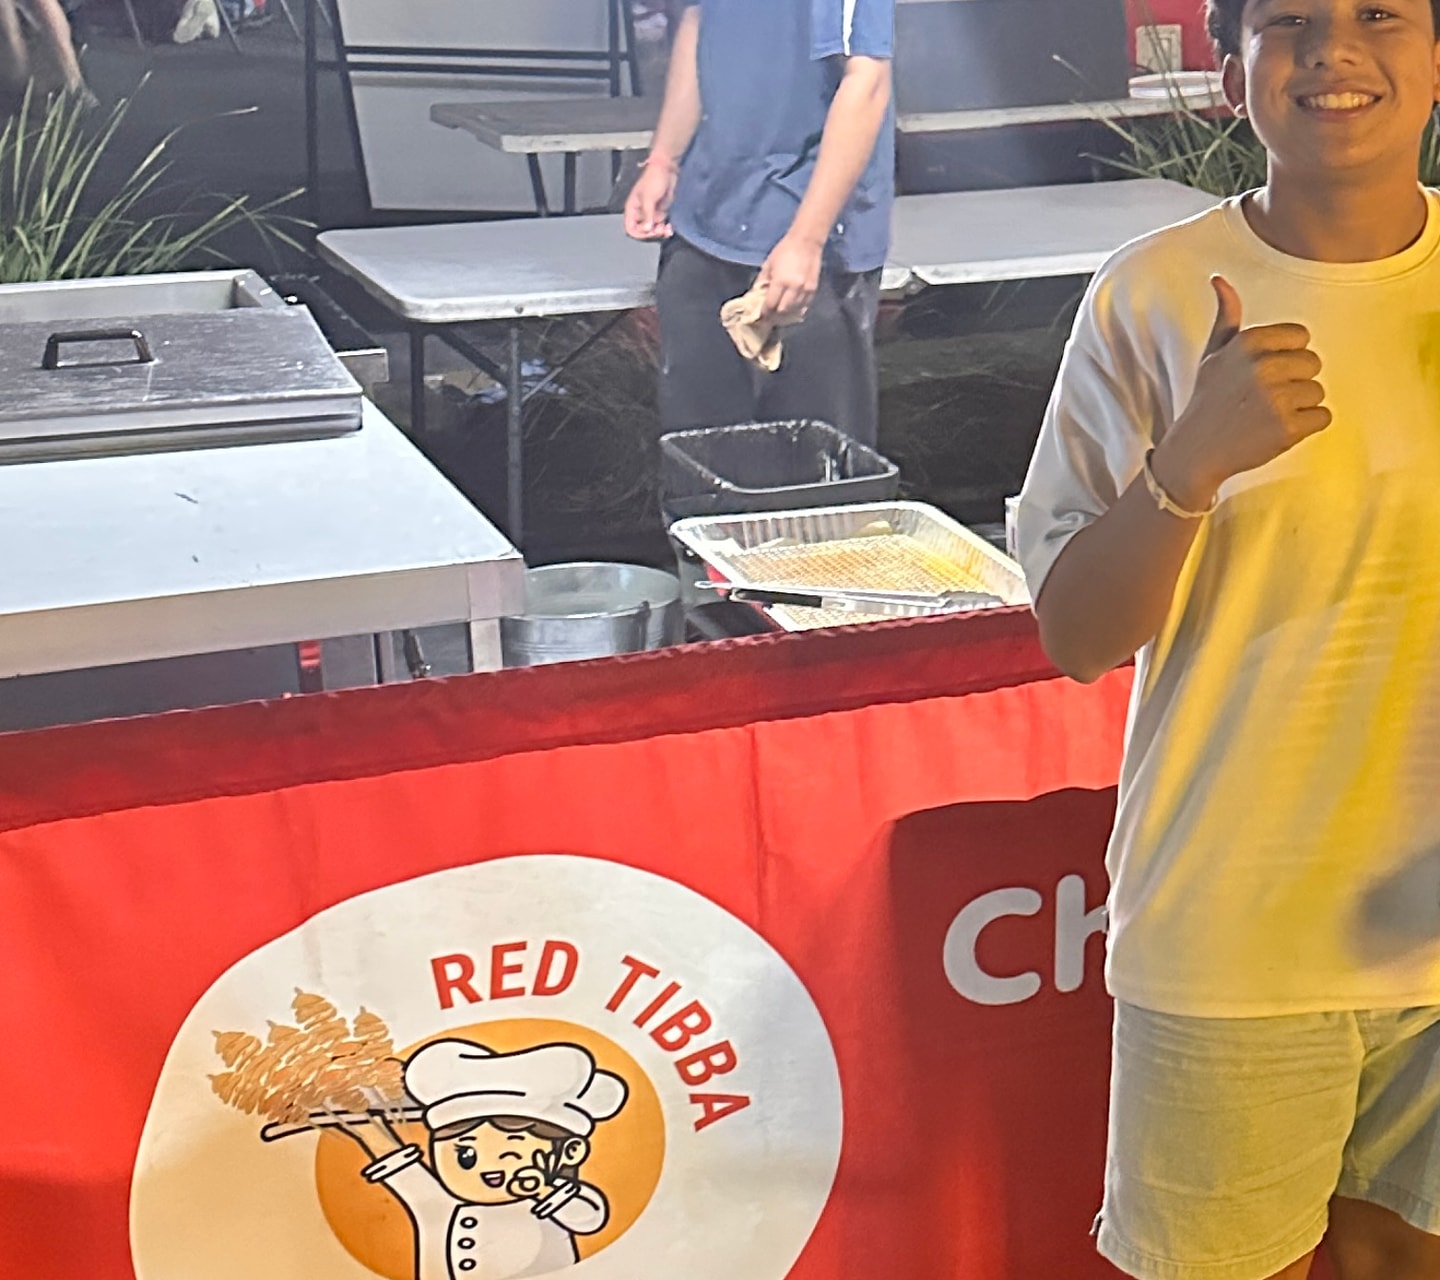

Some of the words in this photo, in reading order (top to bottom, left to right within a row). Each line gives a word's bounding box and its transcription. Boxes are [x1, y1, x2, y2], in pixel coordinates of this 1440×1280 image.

[943, 874, 1109, 1006] Ch
[430, 939, 579, 1010] RED
[604, 954, 751, 1133] TIBBA
